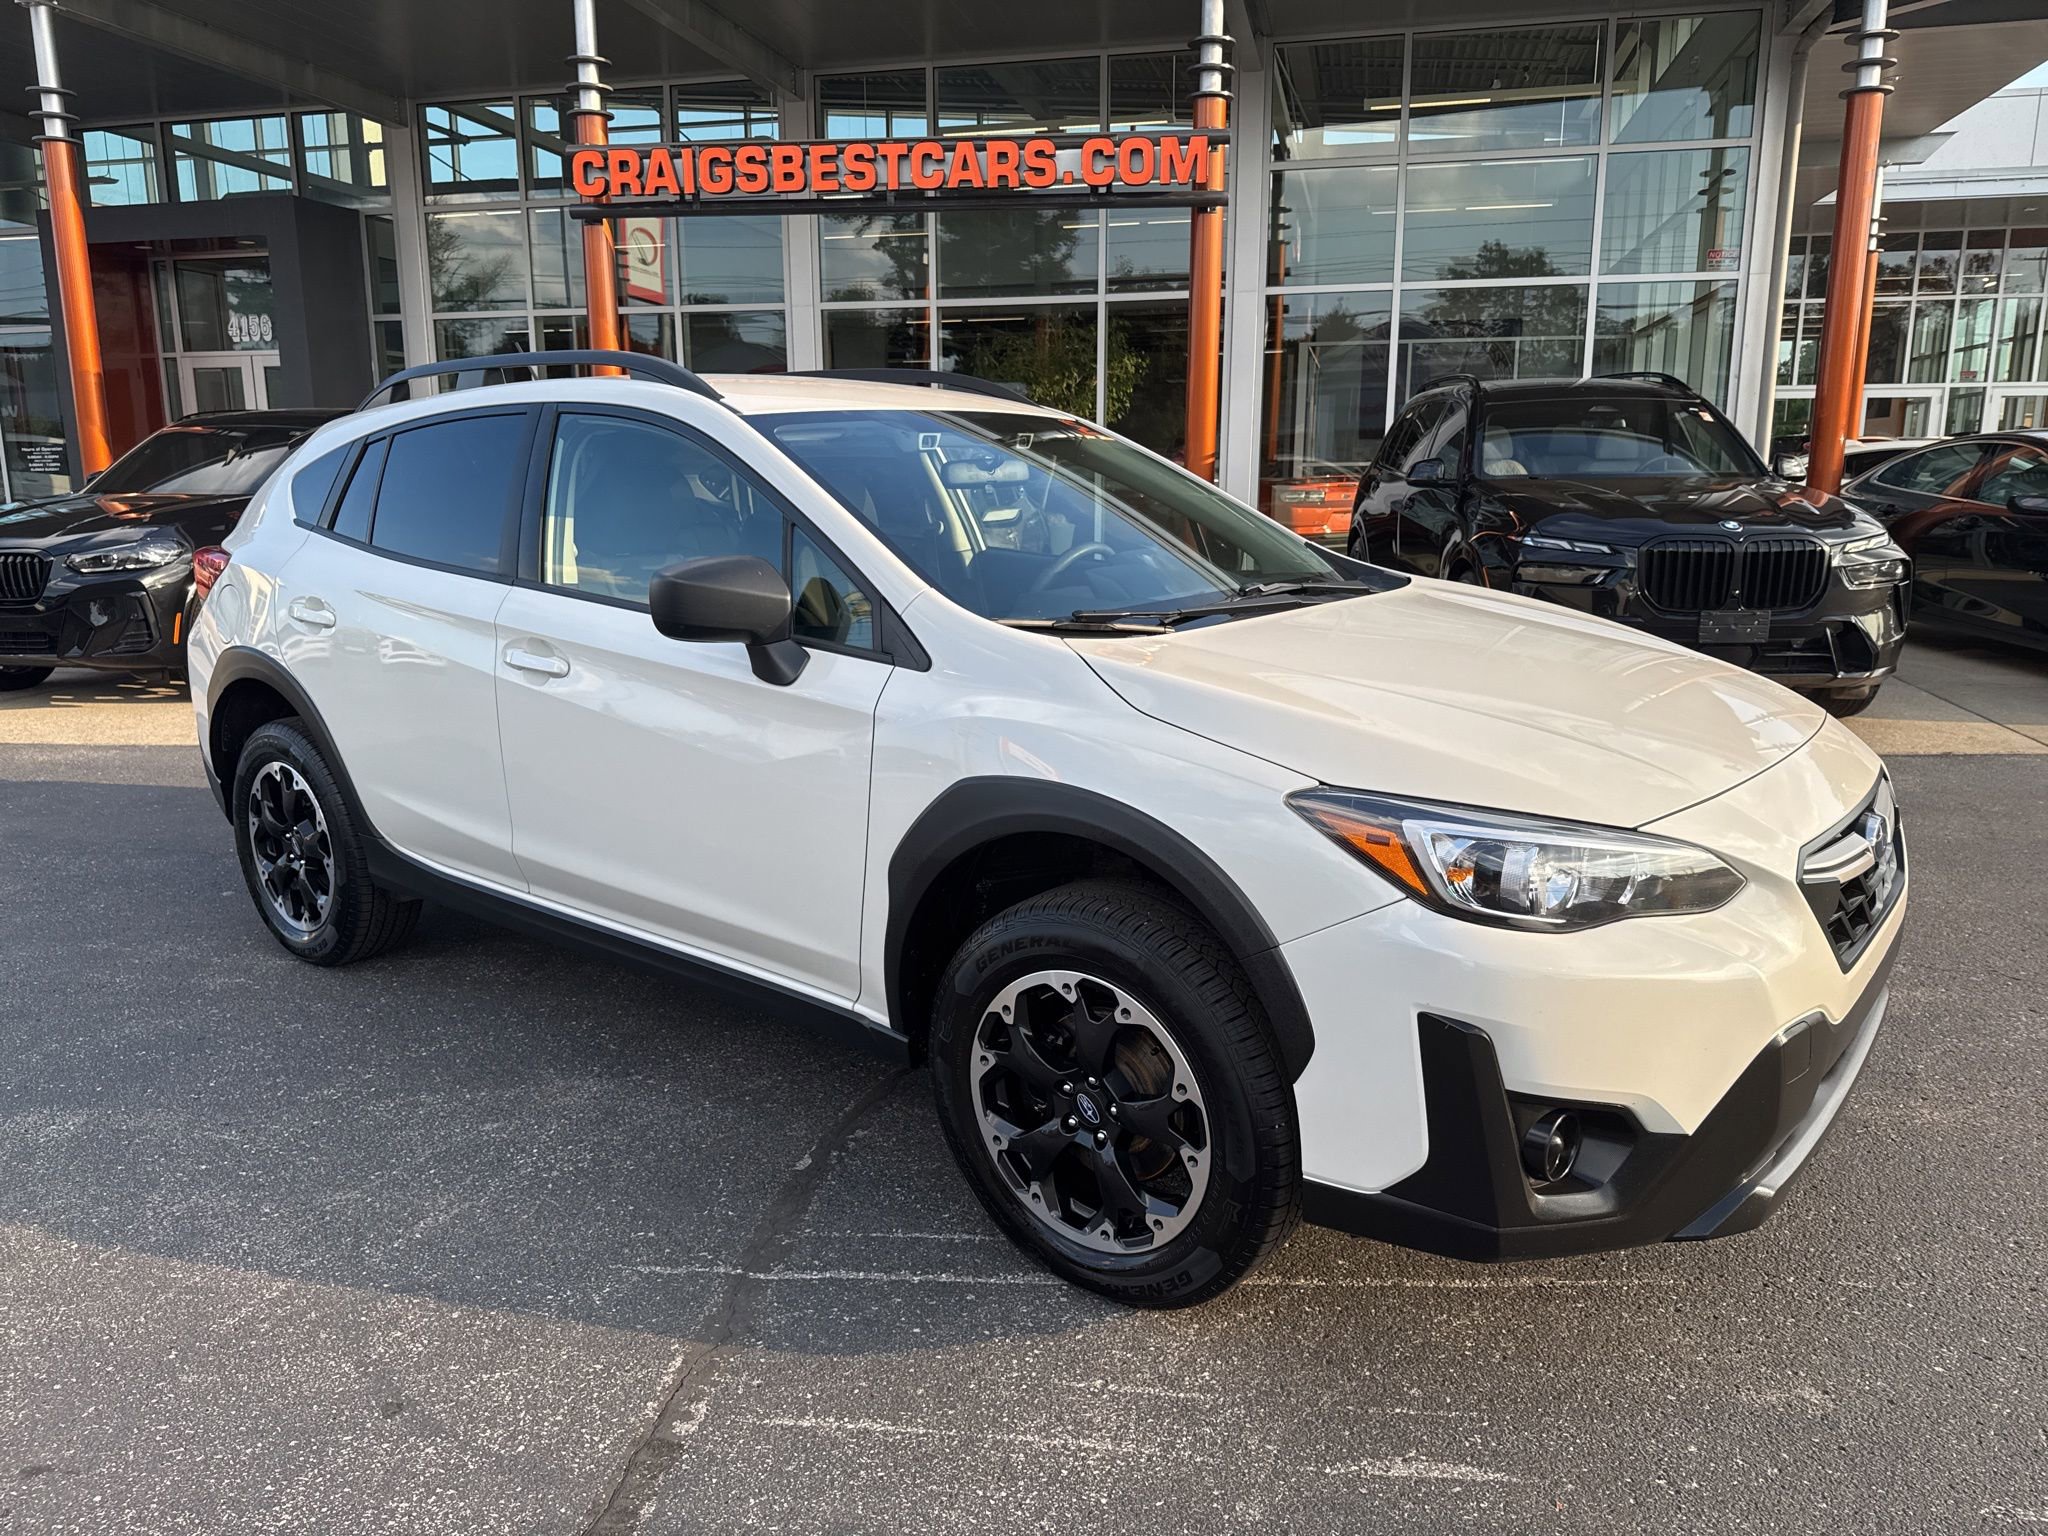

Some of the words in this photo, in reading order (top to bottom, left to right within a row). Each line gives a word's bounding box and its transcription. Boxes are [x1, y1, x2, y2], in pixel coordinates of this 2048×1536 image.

[572, 135, 1209, 197] CRAIGSBESTCARS.COM
[1708, 250, 1738, 258] NOTICE
[228, 312, 272, 342] 4156
[976, 936, 1077, 973] GENERAL
[1100, 1270, 1193, 1298] GENER
